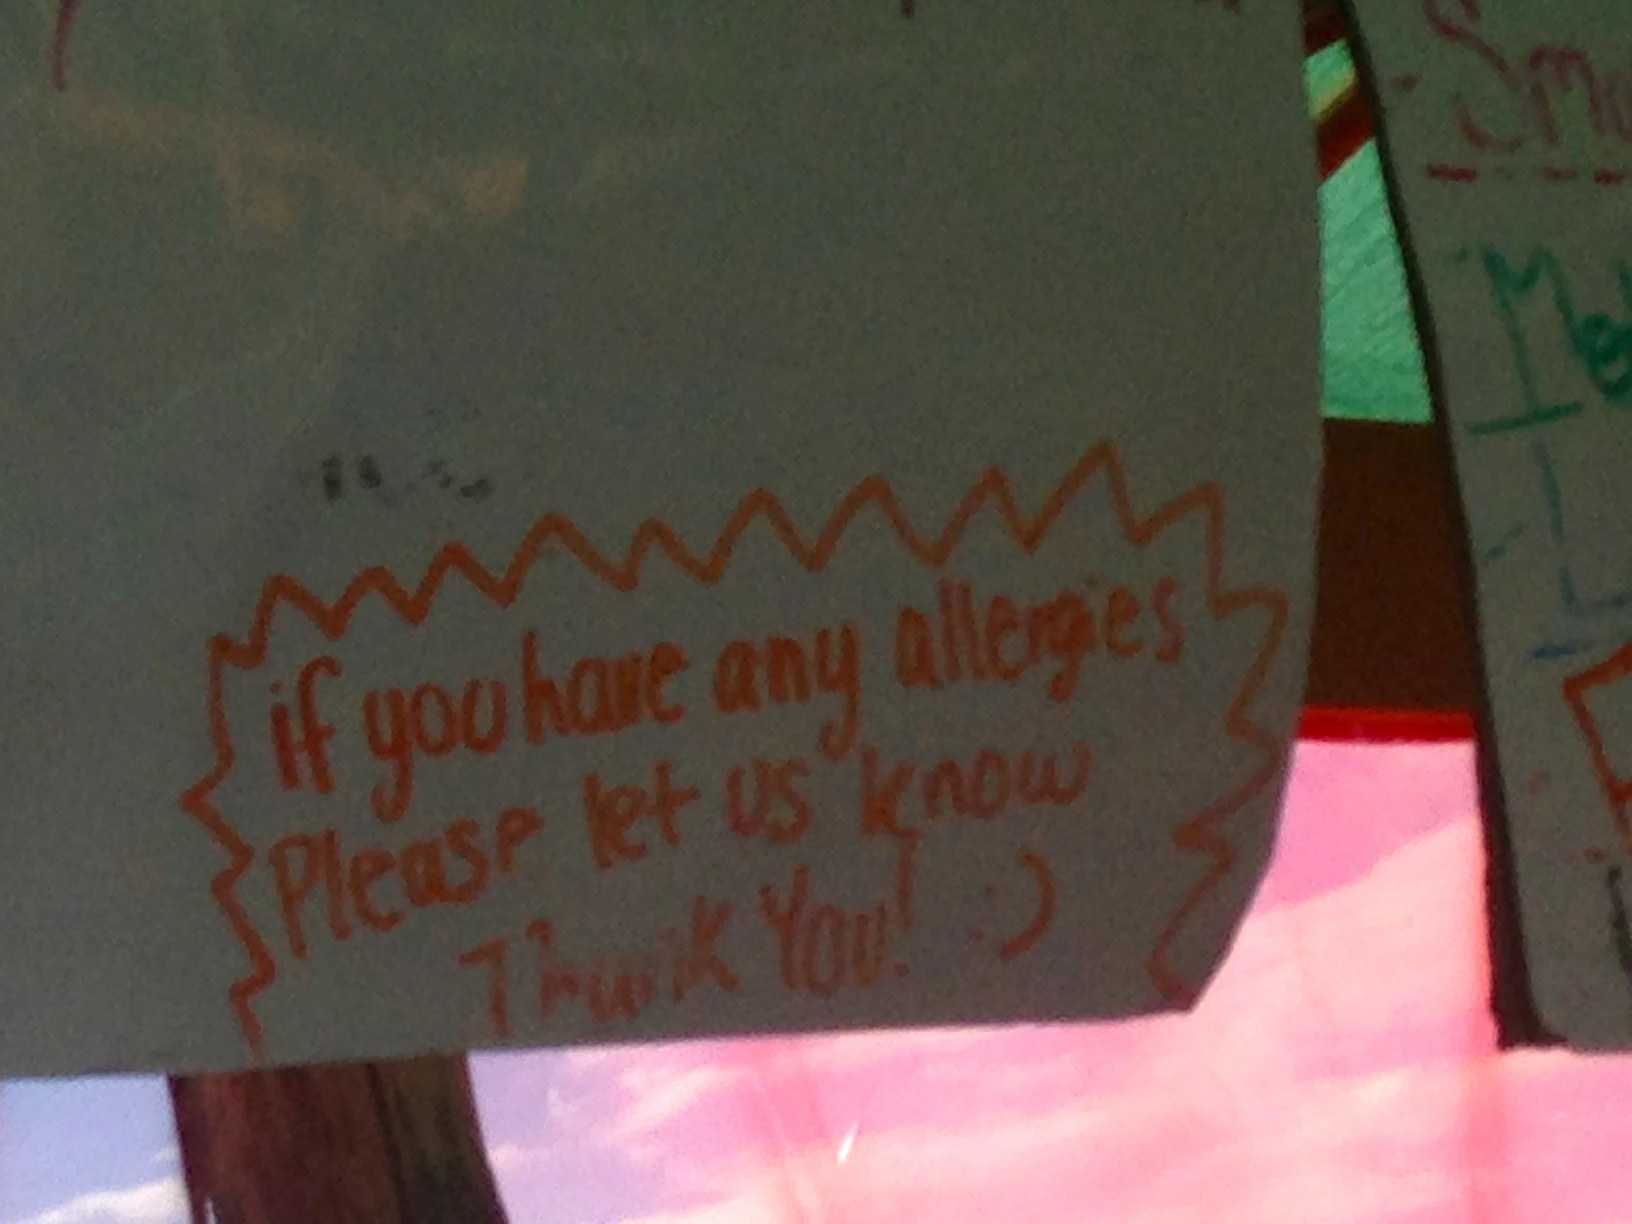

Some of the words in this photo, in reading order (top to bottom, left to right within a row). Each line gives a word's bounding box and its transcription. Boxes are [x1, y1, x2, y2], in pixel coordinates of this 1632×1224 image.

[268, 652, 341, 793] if
[362, 678, 510, 825] you
[520, 628, 691, 745] have
[711, 617, 861, 761] any
[892, 576, 1185, 702] allergies
[266, 804, 544, 958] Please
[581, 758, 702, 871] let
[724, 754, 811, 845] us
[860, 738, 1094, 836] know
